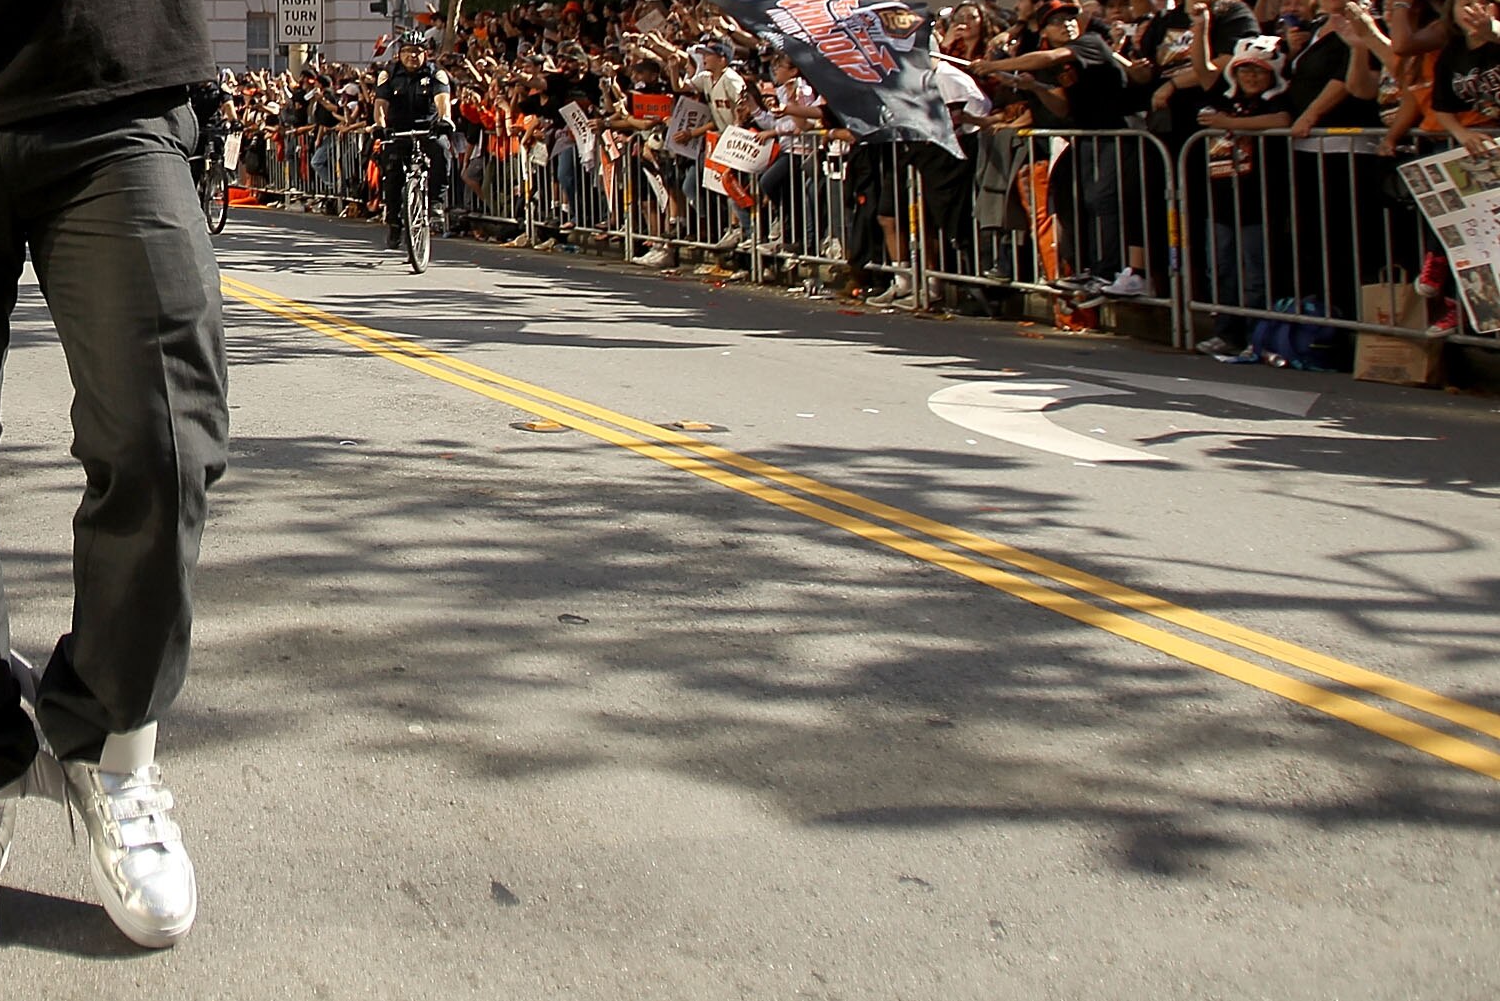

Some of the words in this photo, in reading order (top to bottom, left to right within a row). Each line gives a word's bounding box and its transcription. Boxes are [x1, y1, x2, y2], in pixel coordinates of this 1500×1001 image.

[284, 10, 317, 22] TURN
[284, 25, 316, 37] ONLY
[726, 139, 761, 159] GIANTS
